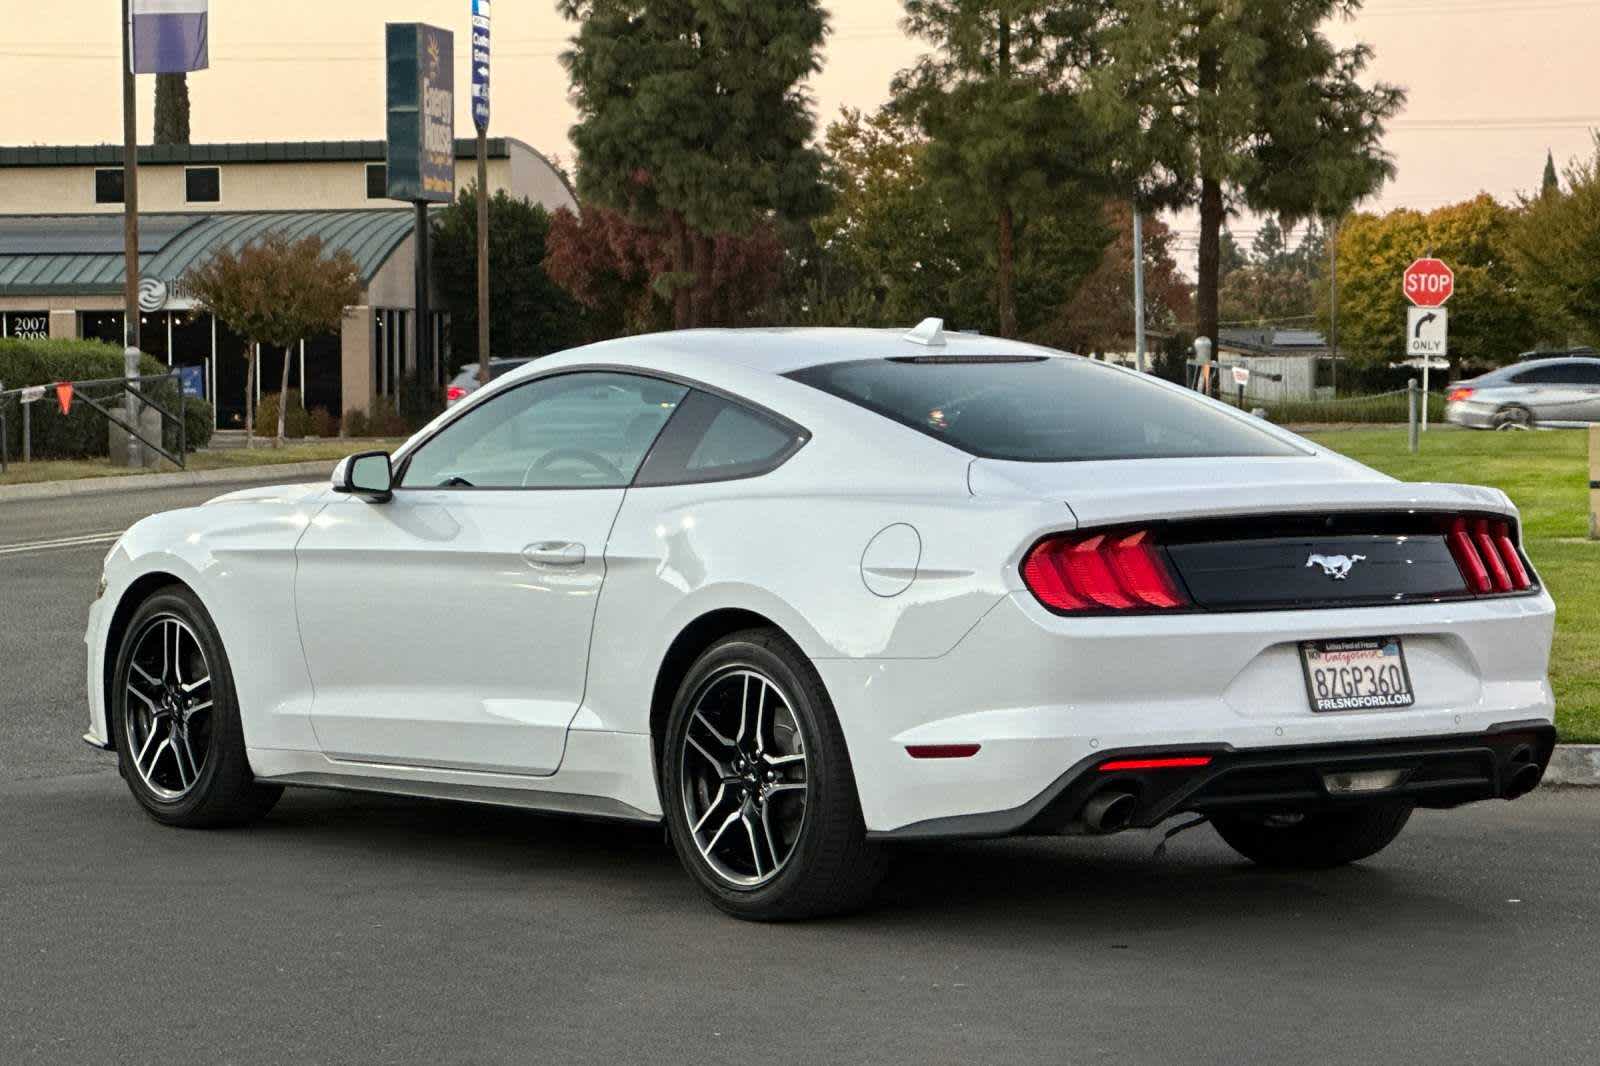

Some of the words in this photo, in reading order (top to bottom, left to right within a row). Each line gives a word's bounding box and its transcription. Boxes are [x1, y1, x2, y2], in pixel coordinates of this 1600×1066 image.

[1407, 273, 1450, 293] STOP
[15, 317, 46, 331] 2007
[1412, 341, 1441, 351] ONLY
[1324, 650, 1378, 665] California
[1315, 664, 1403, 697] 8ZGP360
[1317, 693, 1412, 710] FRESNOFORD.COM
